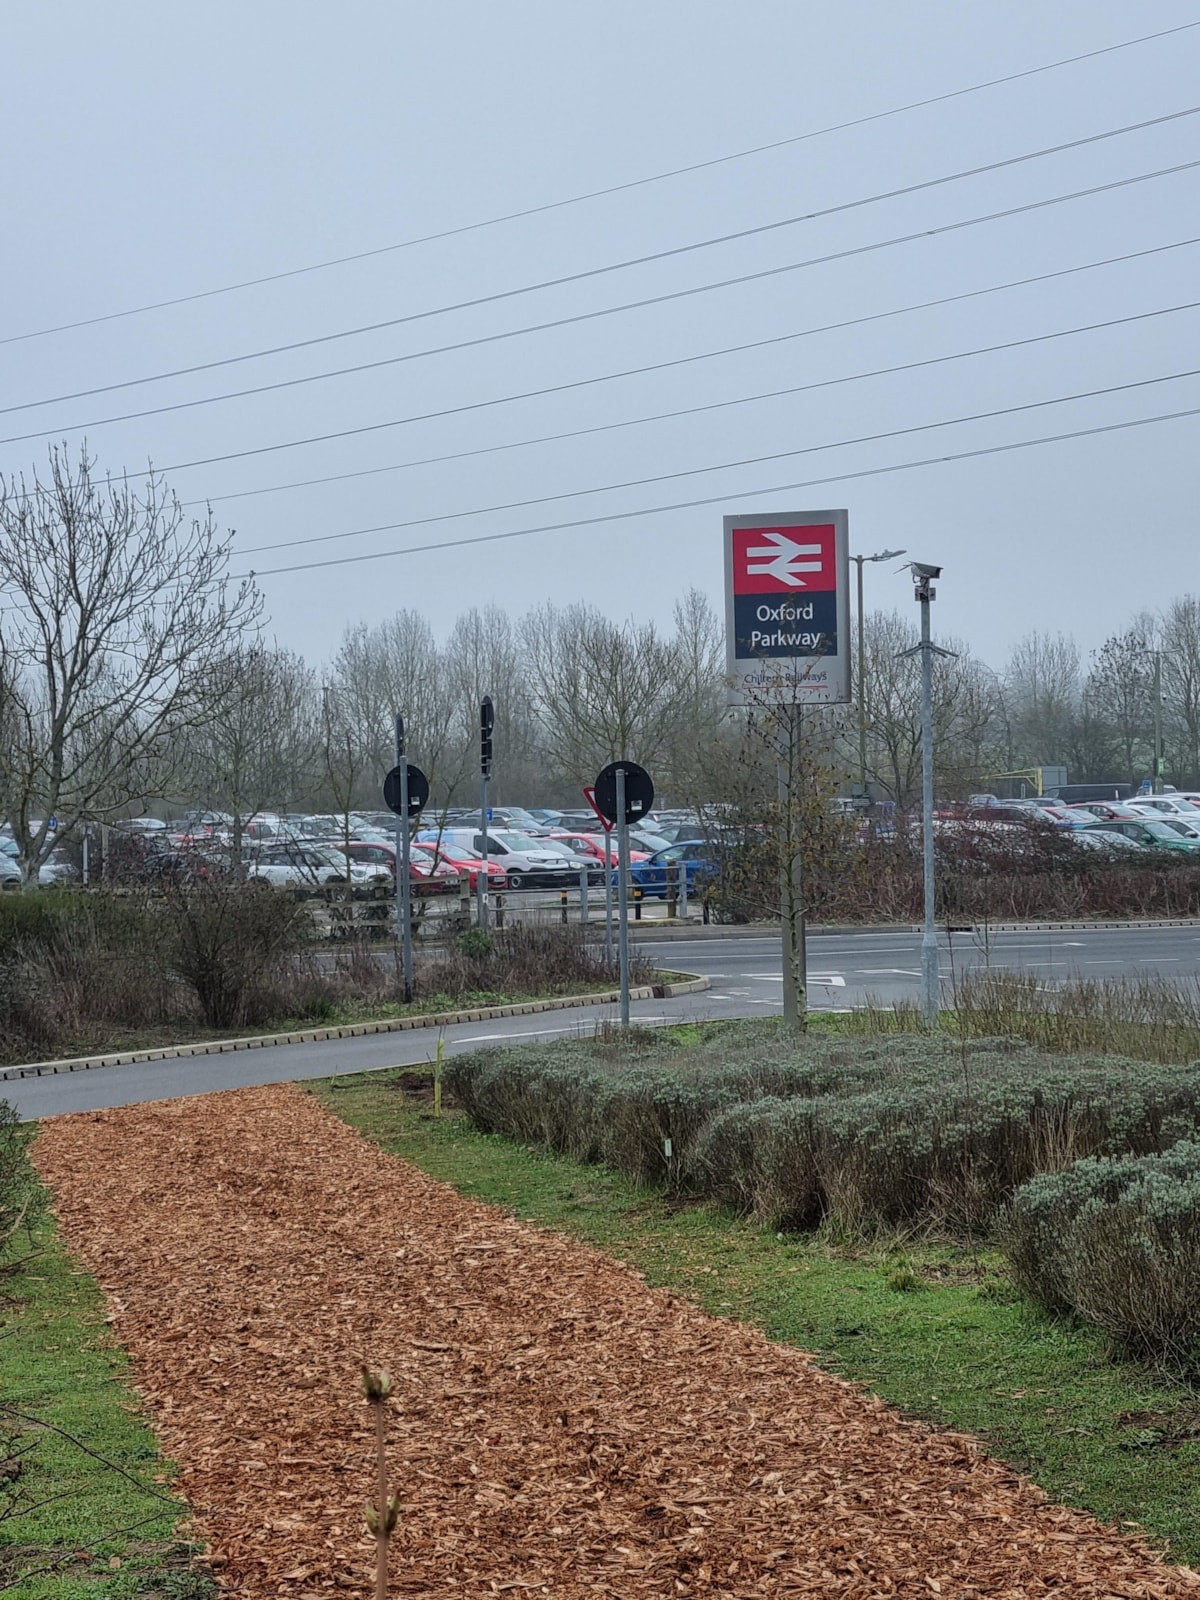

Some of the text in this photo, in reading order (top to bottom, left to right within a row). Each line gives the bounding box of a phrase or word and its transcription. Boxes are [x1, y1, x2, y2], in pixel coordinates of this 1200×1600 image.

[756, 603, 813, 622] Oxford
[751, 629, 821, 649] Parkway
[785, 671, 827, 683] Rilways
